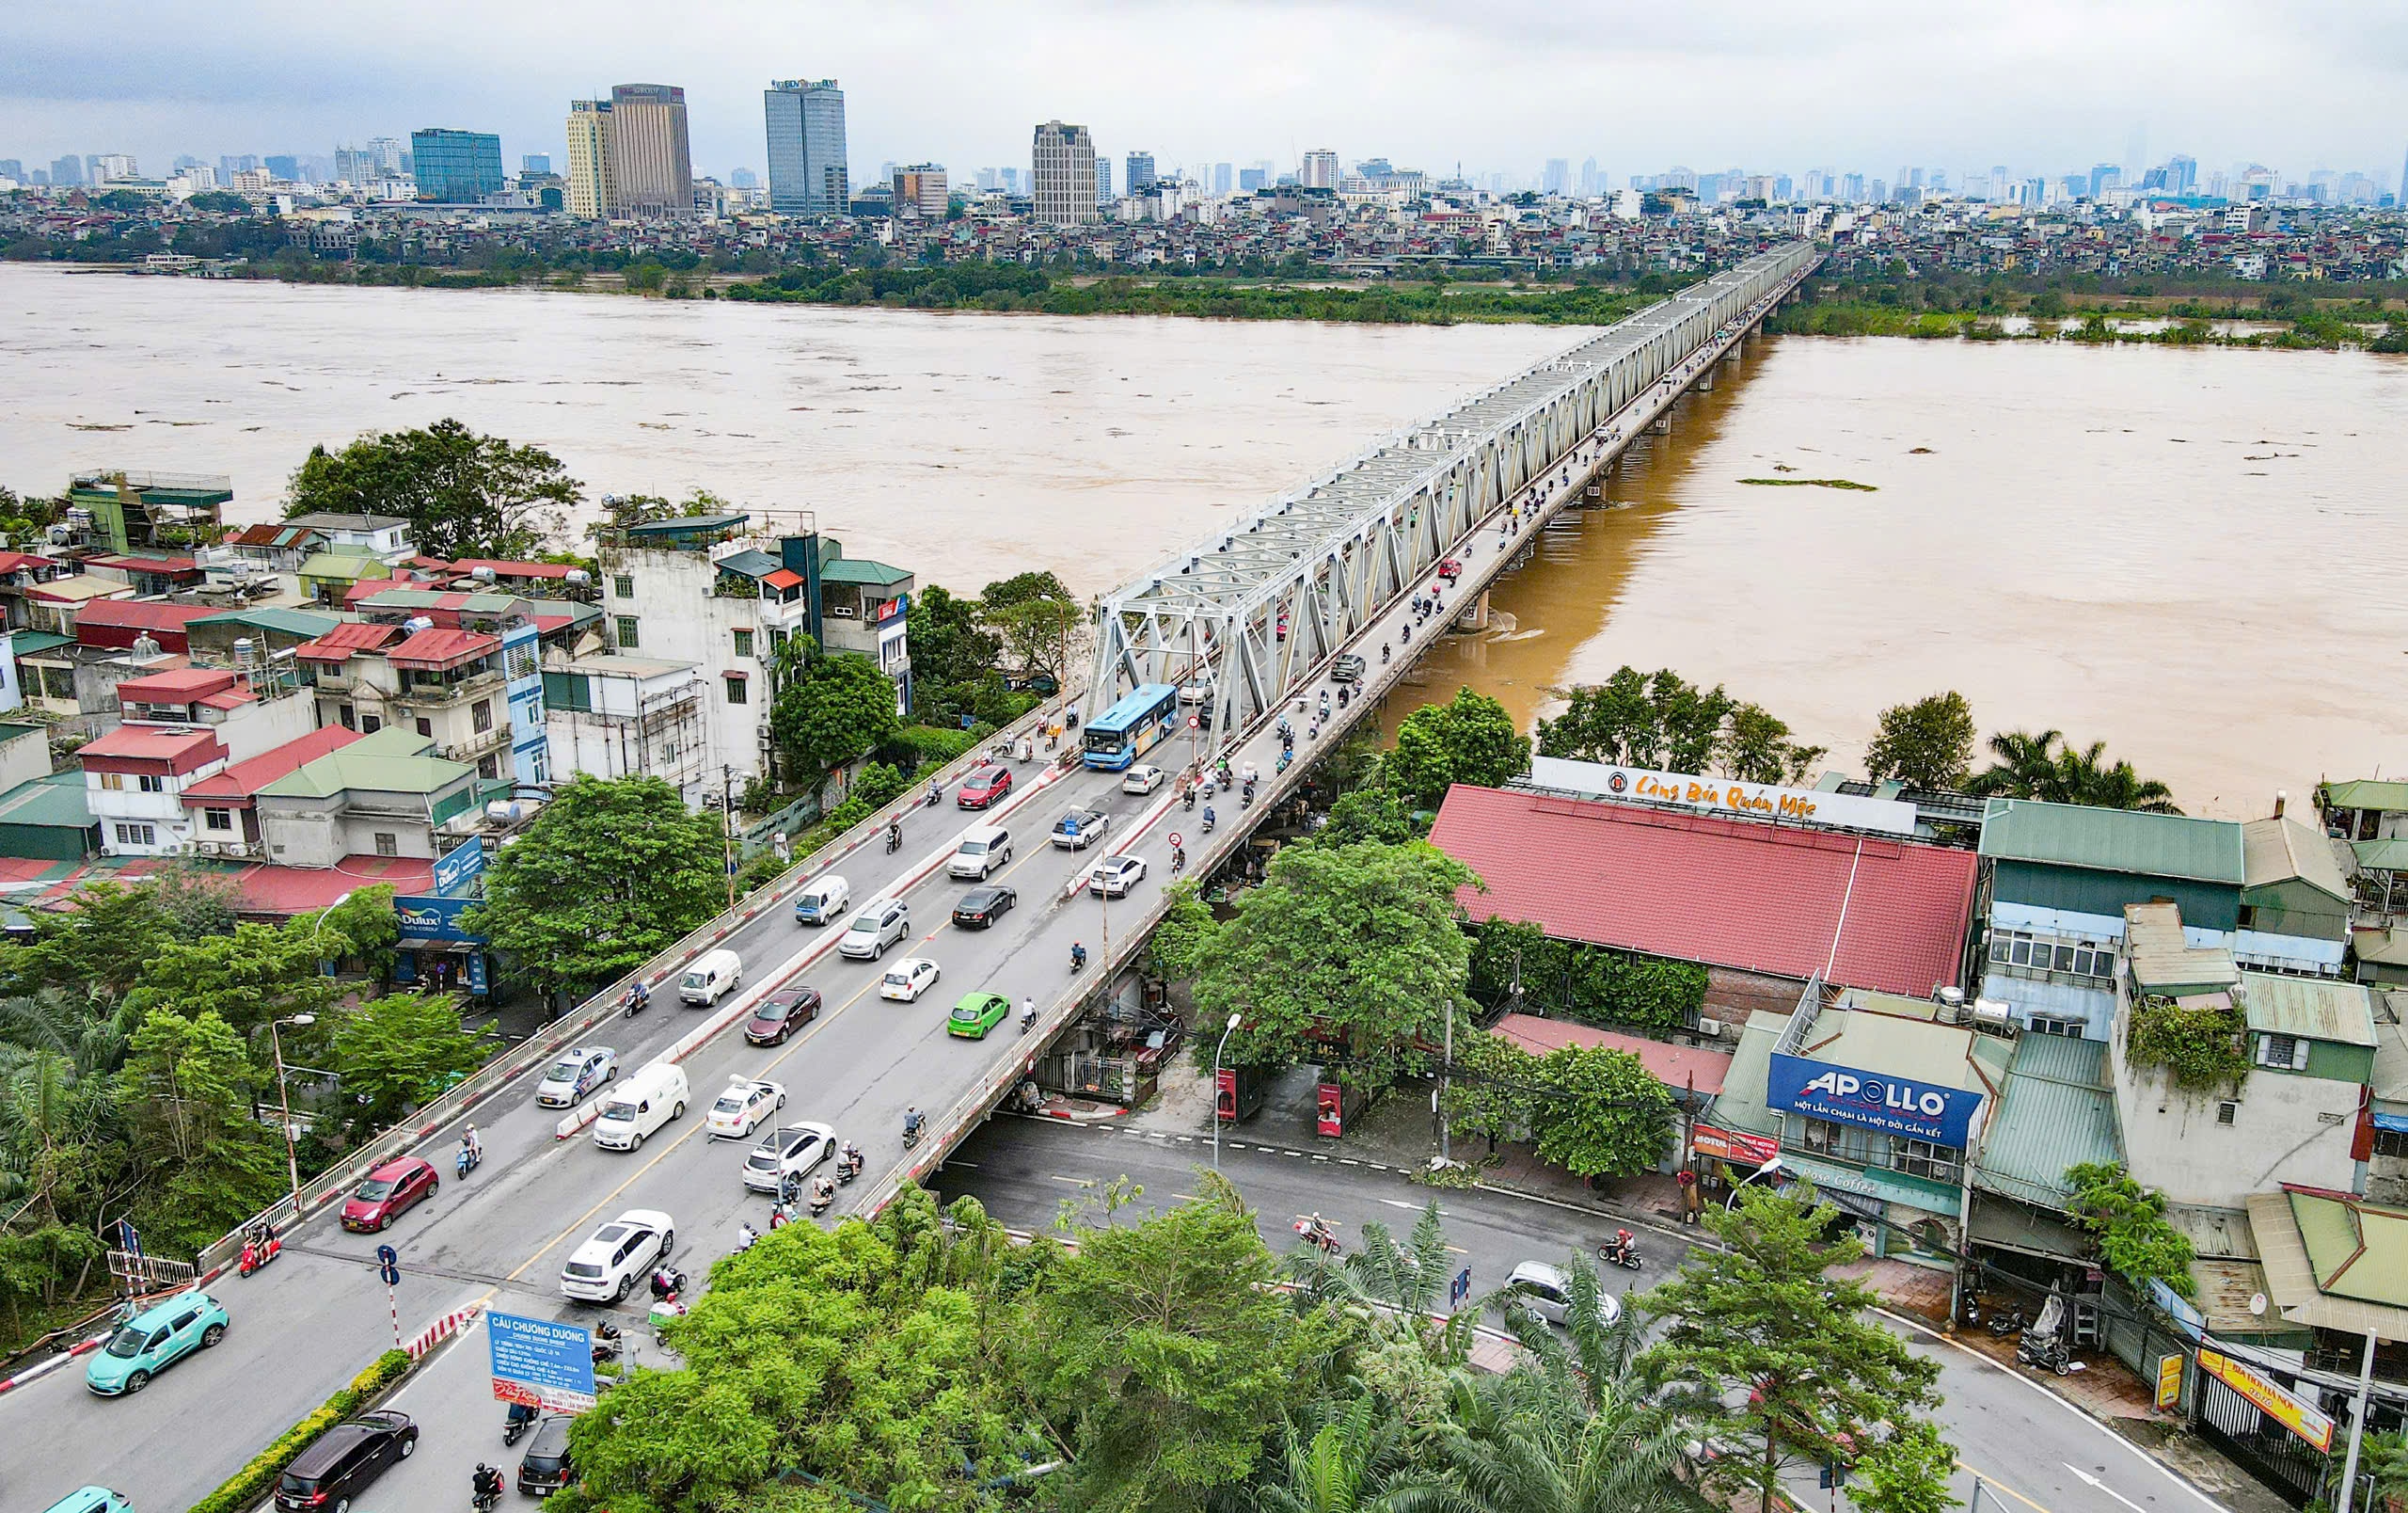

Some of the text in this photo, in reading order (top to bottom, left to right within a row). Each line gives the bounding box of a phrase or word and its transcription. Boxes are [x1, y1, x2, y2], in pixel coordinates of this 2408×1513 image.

[1636, 775, 1817, 820] Làng Bia Quán Mộc
[438, 869, 458, 887] Dulux
[402, 915, 437, 926] Dulux
[1800, 1072, 1944, 1116] APOLLO
[1794, 1101, 1812, 1112] MỘT
[1830, 1108, 1855, 1120] CHẠM
[1857, 1113, 1867, 1123] LÀ
[1868, 1116, 1887, 1127] MỘT
[1694, 1135, 1728, 1148] MOTUL
[1802, 1167, 1876, 1195] Rose Coffee
[492, 1316, 585, 1343] CẦU CHƯƠNG DƯƠNG
